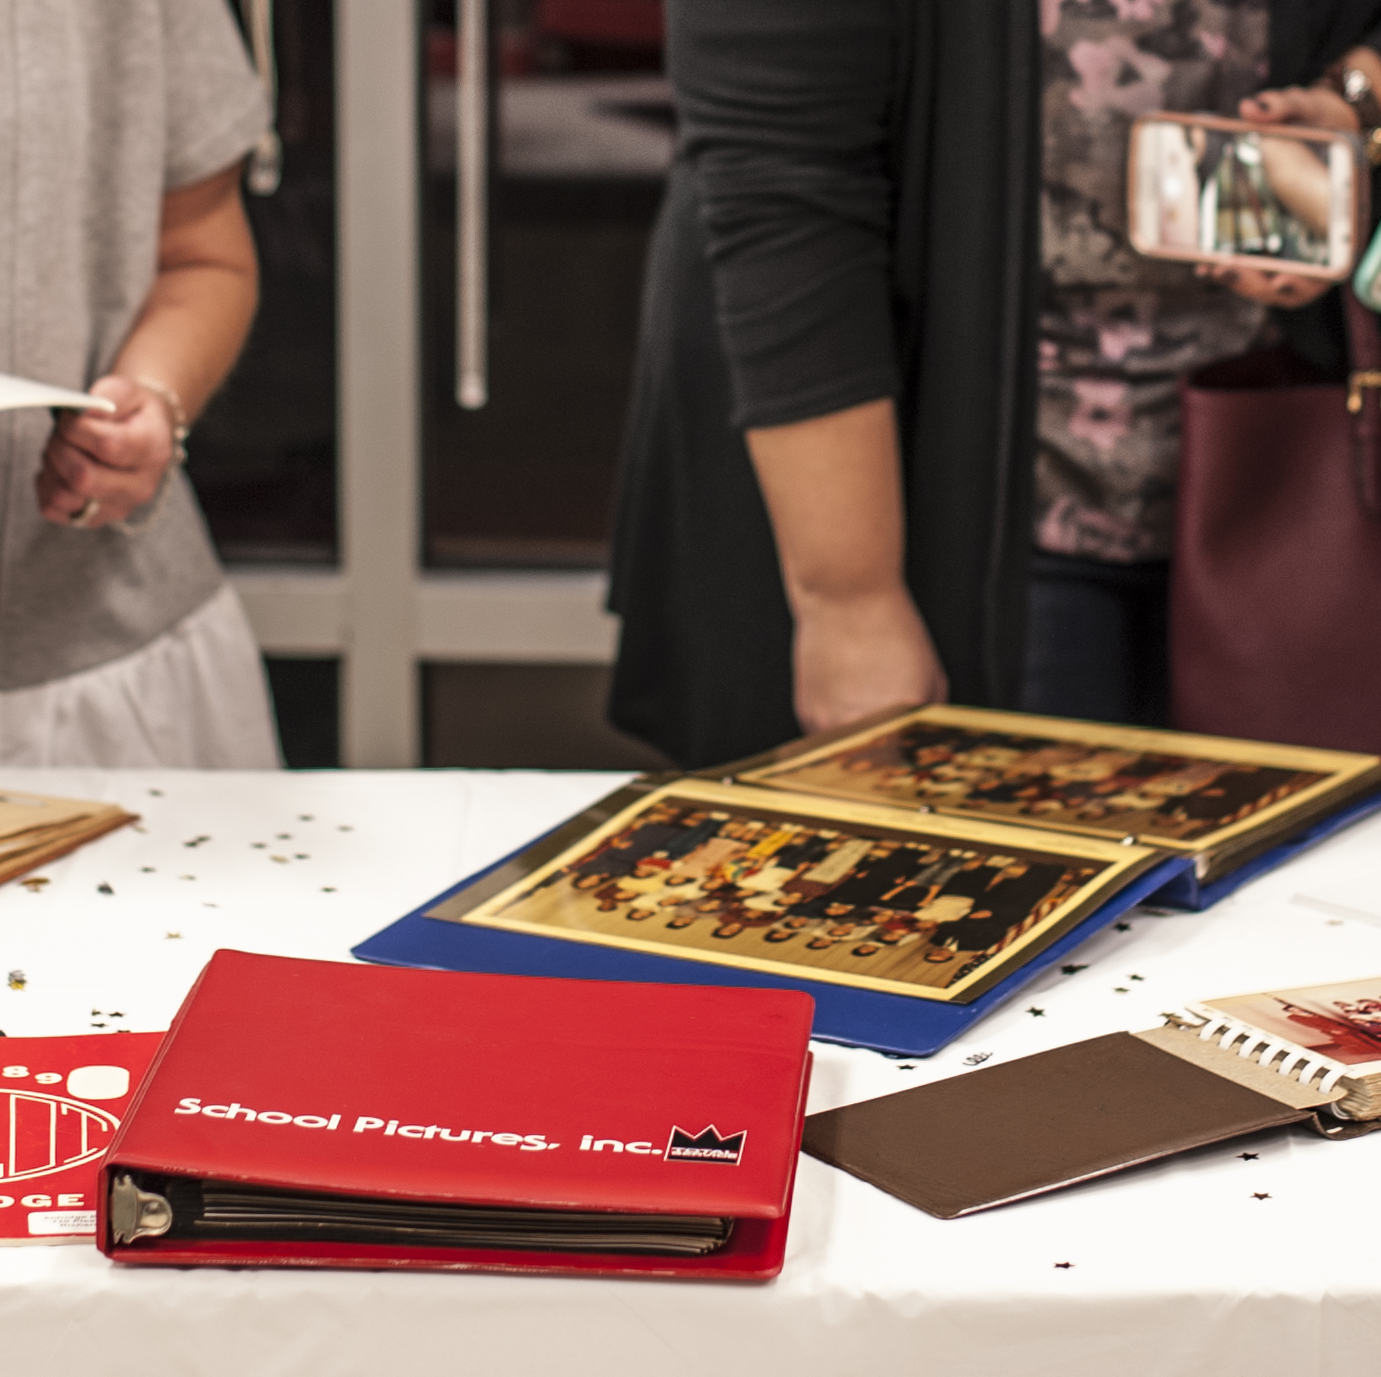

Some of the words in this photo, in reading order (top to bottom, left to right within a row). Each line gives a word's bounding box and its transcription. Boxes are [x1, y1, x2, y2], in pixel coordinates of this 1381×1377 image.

[174, 1097, 342, 1130] School
[353, 1116, 560, 1151] Pictures,
[579, 1133, 663, 1155] inc.
